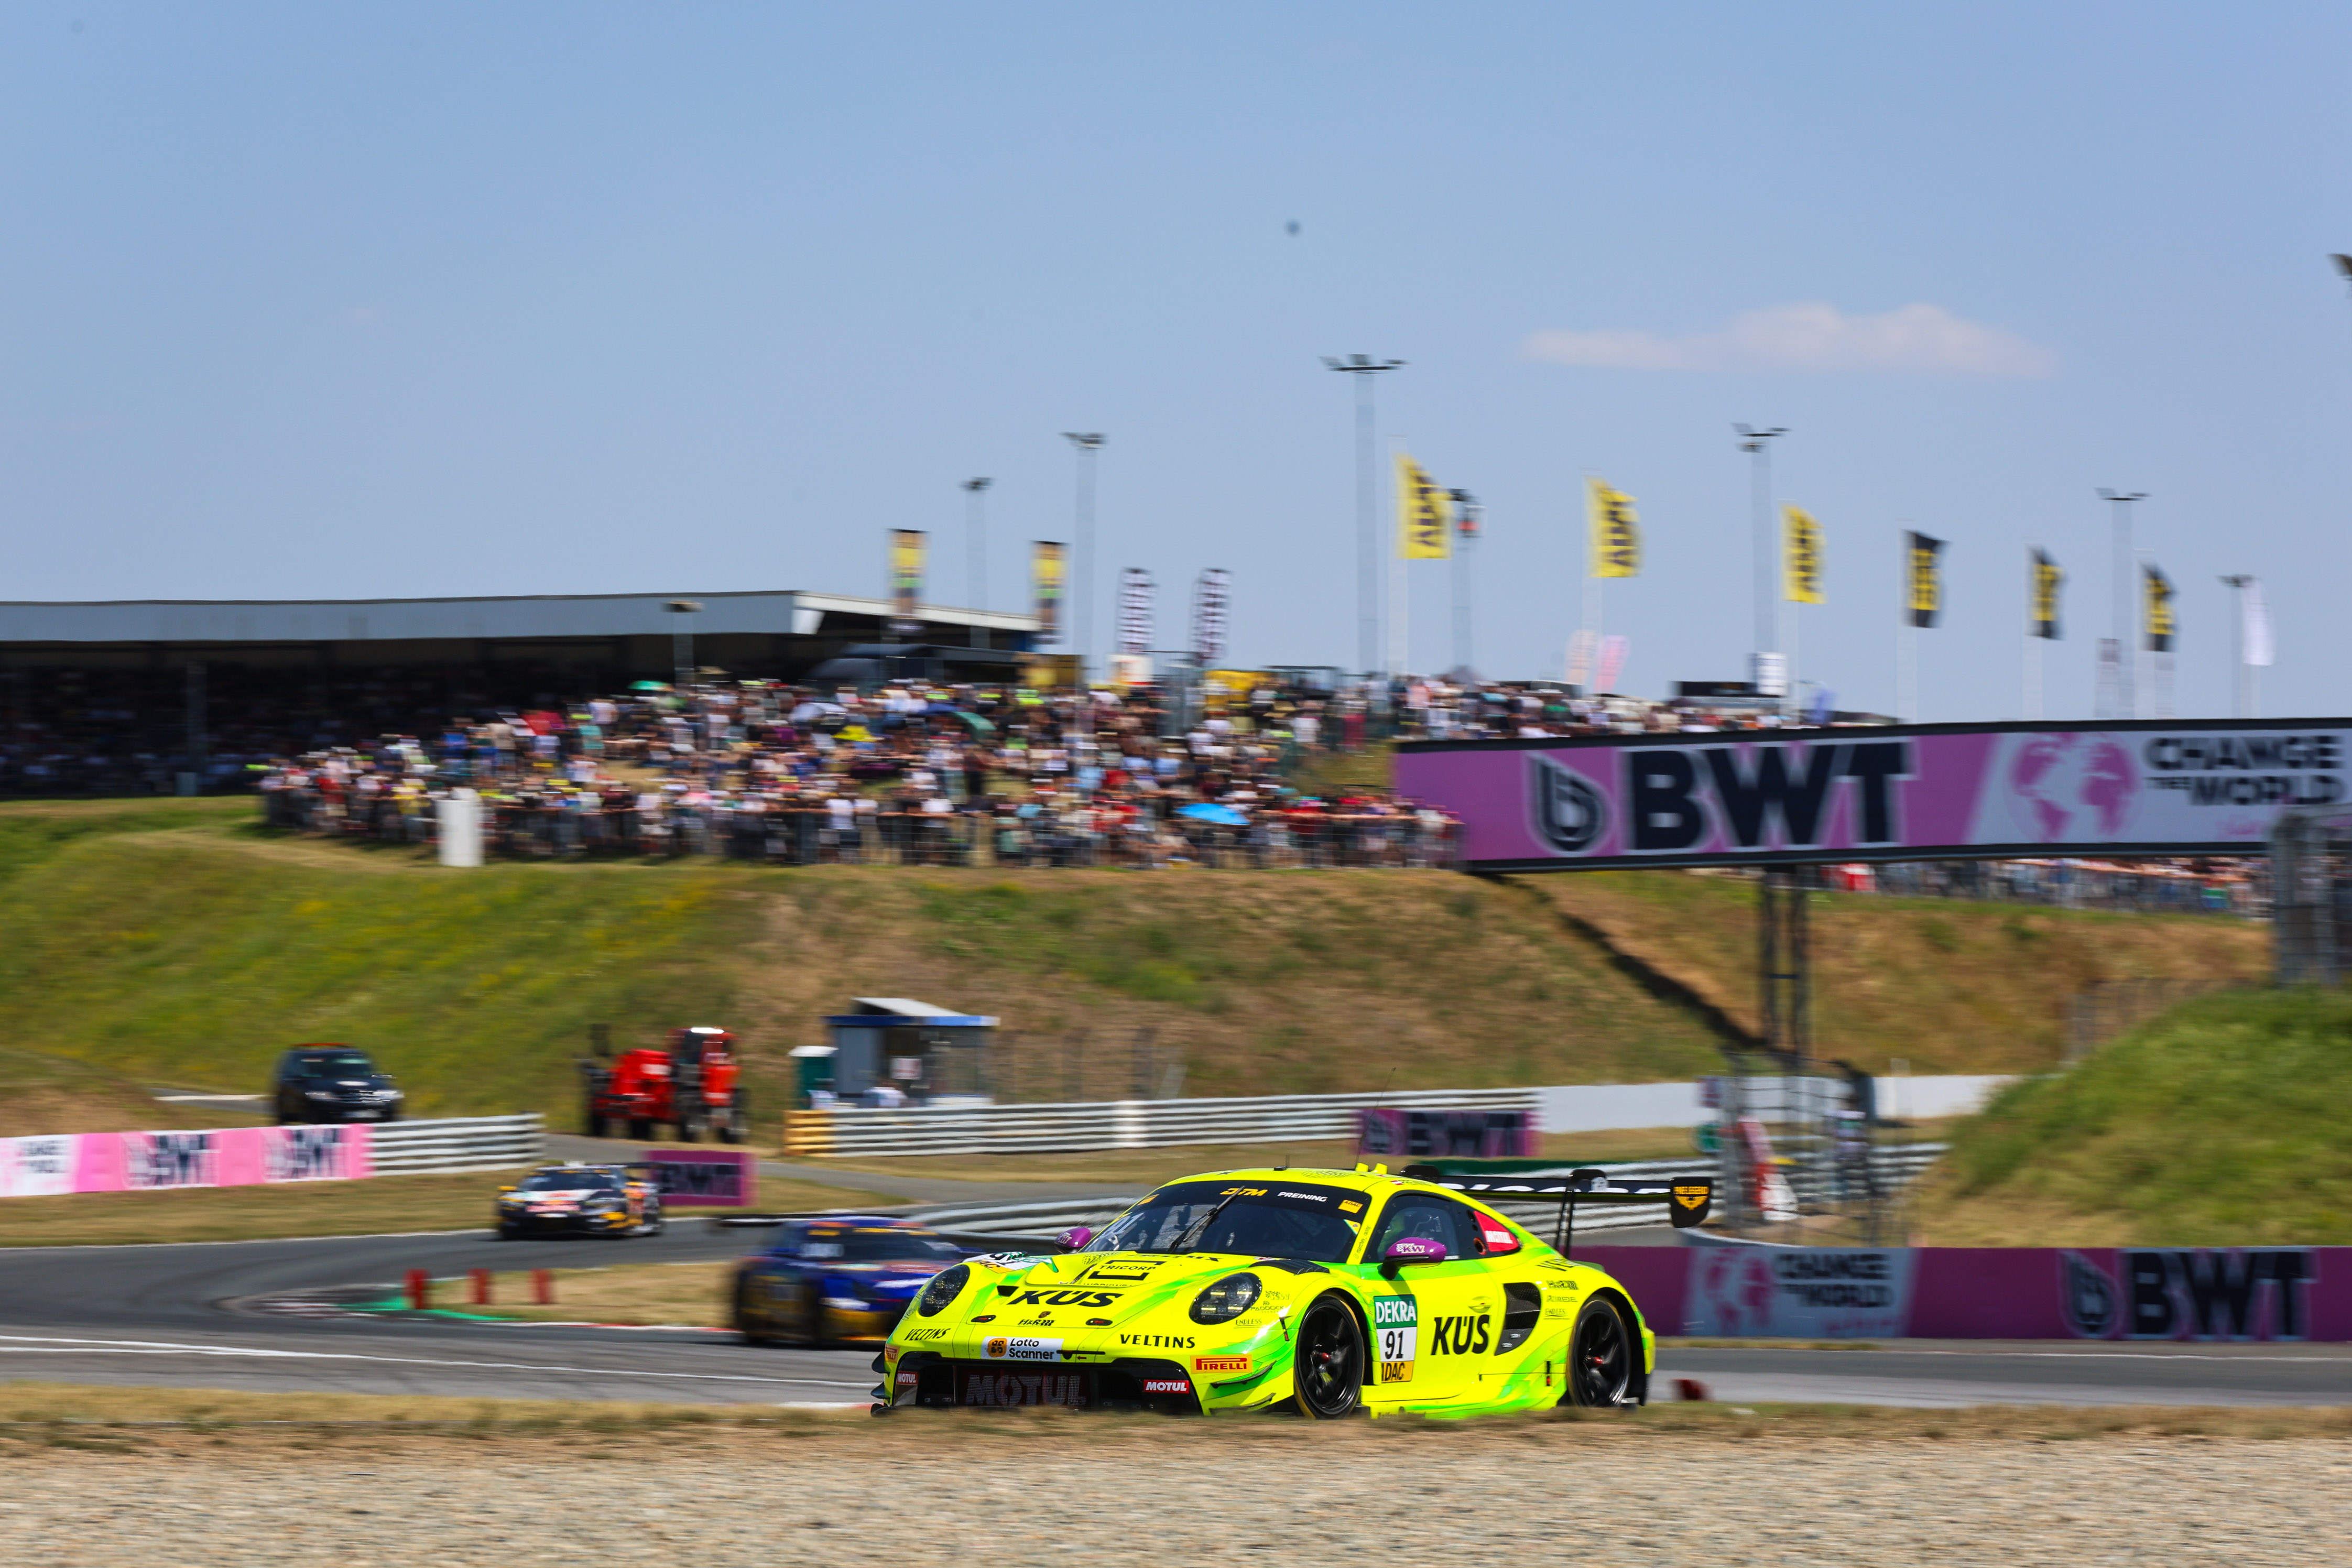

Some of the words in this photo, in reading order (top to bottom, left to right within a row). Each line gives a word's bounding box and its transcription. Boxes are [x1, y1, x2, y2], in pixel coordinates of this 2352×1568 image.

[2142, 735, 2345, 770] CHANGE
[1629, 742, 1908, 850] BWT
[2188, 774, 2348, 806] WORLD
[1277, 1191, 1328, 1202] PREINING
[1006, 1290, 1123, 1307] KÜS
[2130, 1252, 2312, 1335] BWT
[1375, 1301, 1417, 1323] DEKRA
[904, 1328, 951, 1341] VELTINS
[1010, 1338, 1039, 1347] Lotto
[1120, 1334, 1195, 1348] VELTINS
[1430, 1314, 1490, 1356] KÜS
[1385, 1330, 1404, 1359] 91
[1009, 1348, 1054, 1360] Scanner
[1196, 1357, 1247, 1370] PIRELLI
[897, 1373, 917, 1383] MOTUL
[1146, 1381, 1187, 1391] MOTUL
[965, 1375, 1086, 1407] MOTUL
